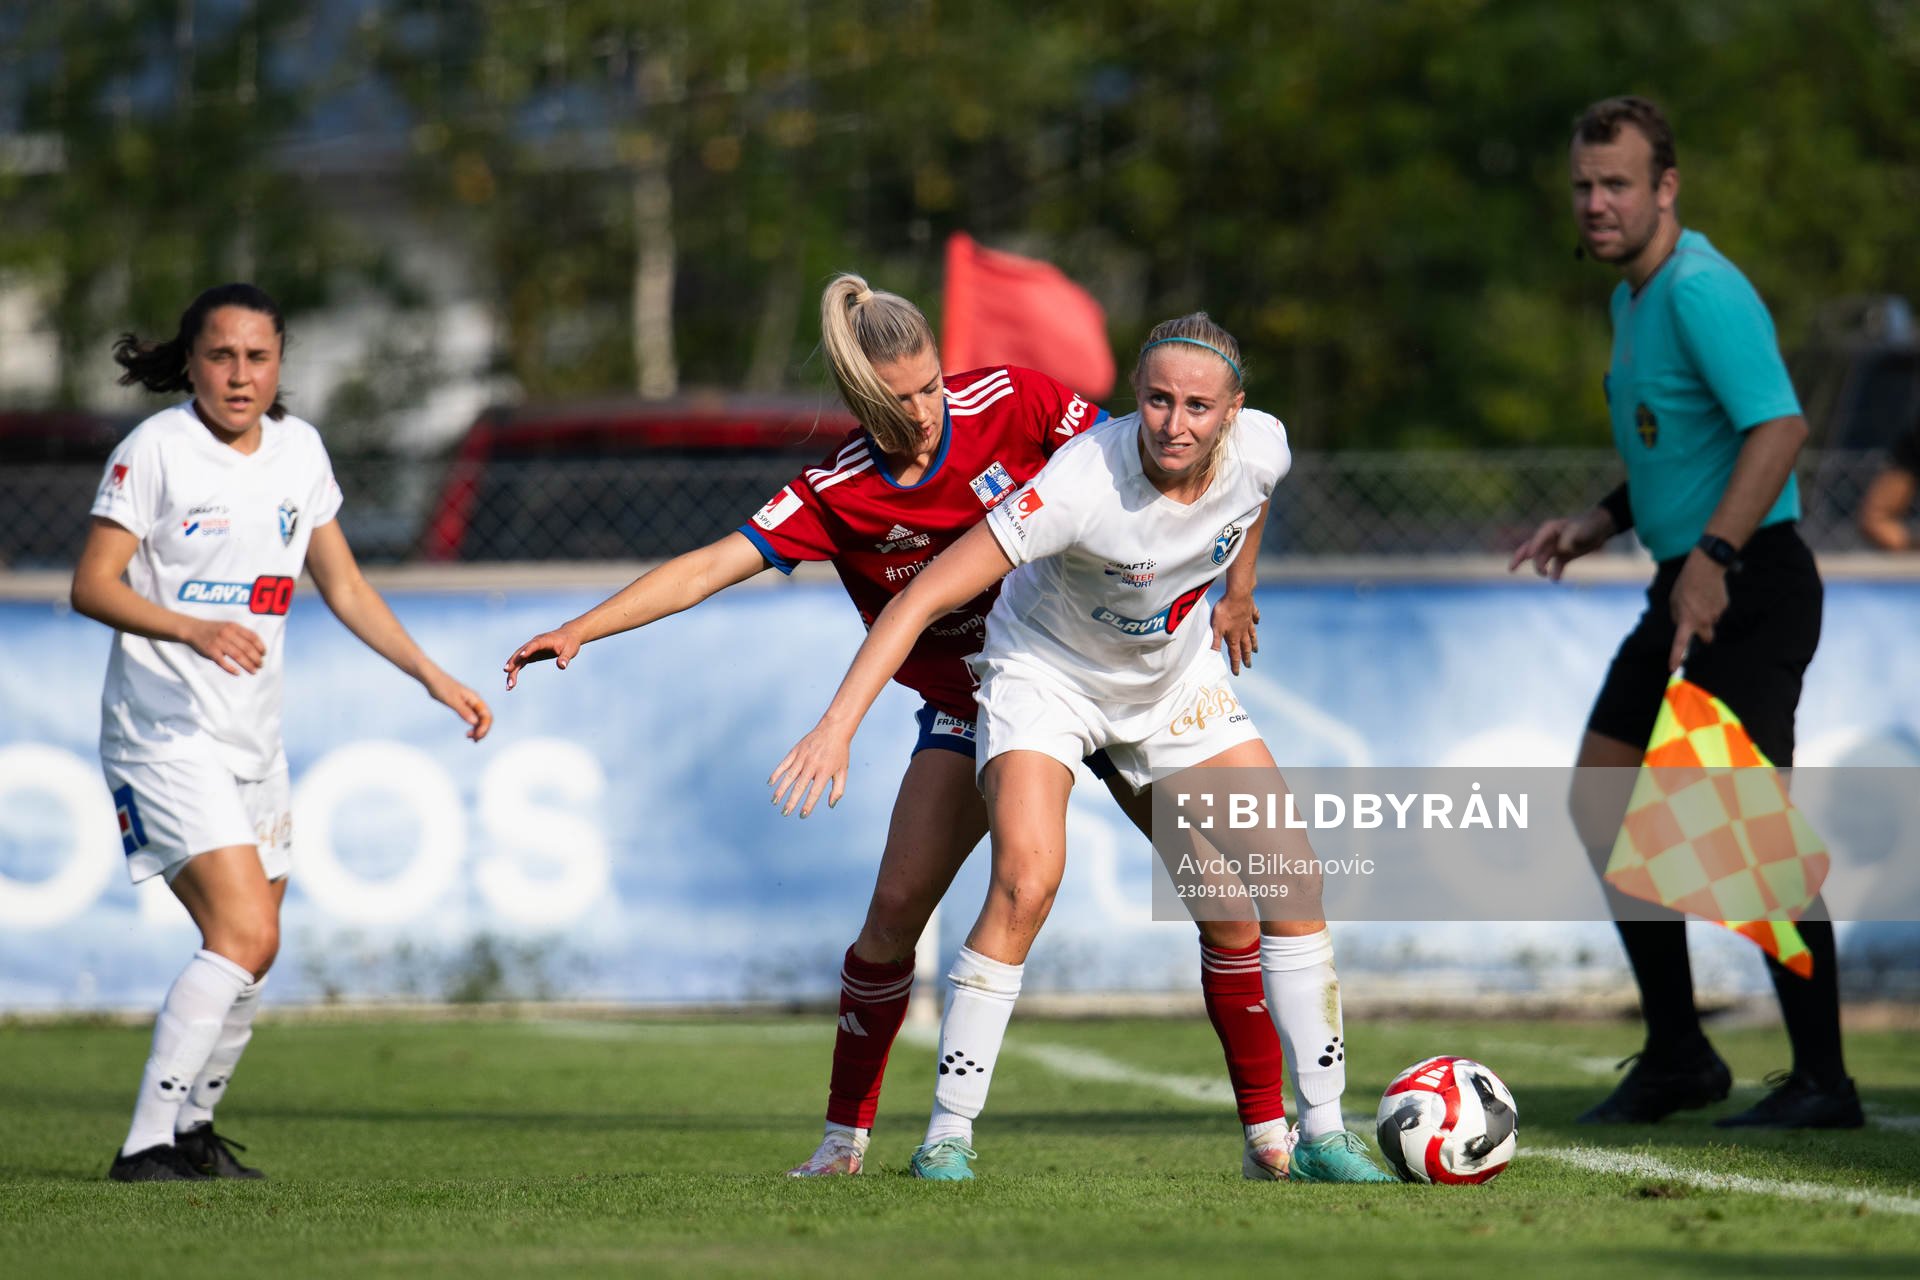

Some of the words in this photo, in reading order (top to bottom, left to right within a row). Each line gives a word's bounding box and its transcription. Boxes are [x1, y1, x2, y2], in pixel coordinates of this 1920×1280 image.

[1054, 393, 1088, 437] VICI
[759, 514, 773, 528] SPEL
[1012, 521, 1027, 542] SPEL
[1107, 561, 1147, 571] CRAFT
[1120, 579, 1153, 588] SPORT
[1121, 572, 1155, 582] INTER
[249, 575, 295, 616] GO
[1165, 576, 1215, 635] G
[937, 718, 977, 732] FRASTE
